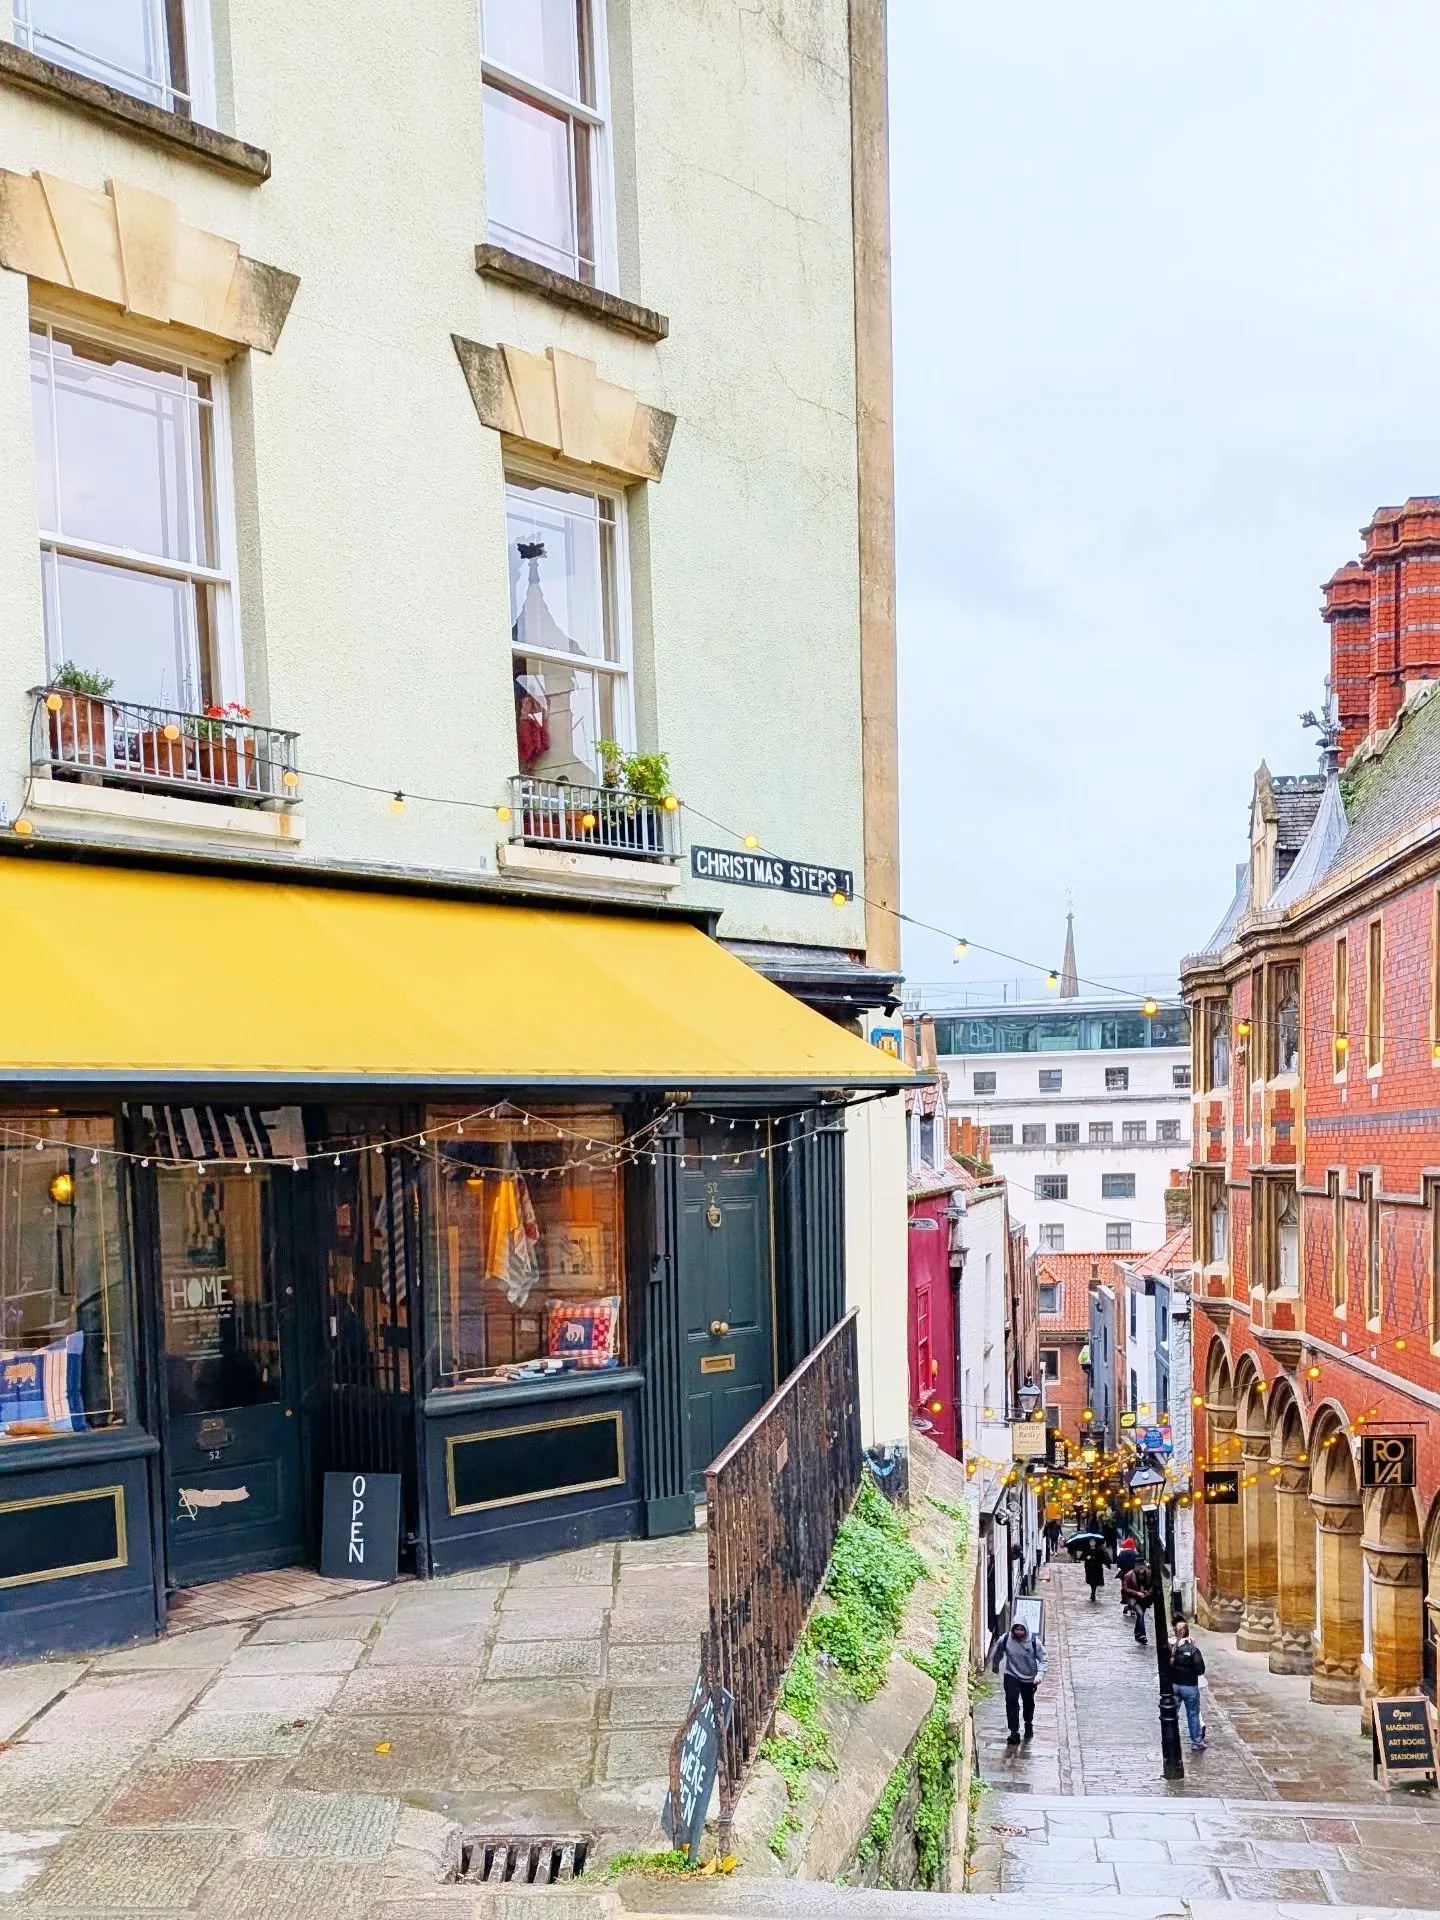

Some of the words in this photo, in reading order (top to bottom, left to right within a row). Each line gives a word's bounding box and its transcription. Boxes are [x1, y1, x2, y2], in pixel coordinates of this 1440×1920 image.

[696, 850, 784, 885] CHRISTMAS
[790, 865, 837, 893] STEPS
[707, 1182, 718, 1194] 52
[170, 1275, 233, 1310] HOME
[209, 1450, 221, 1461] 52
[1207, 1483, 1236, 1492] HUK
[348, 1475, 366, 1563] OPEN
